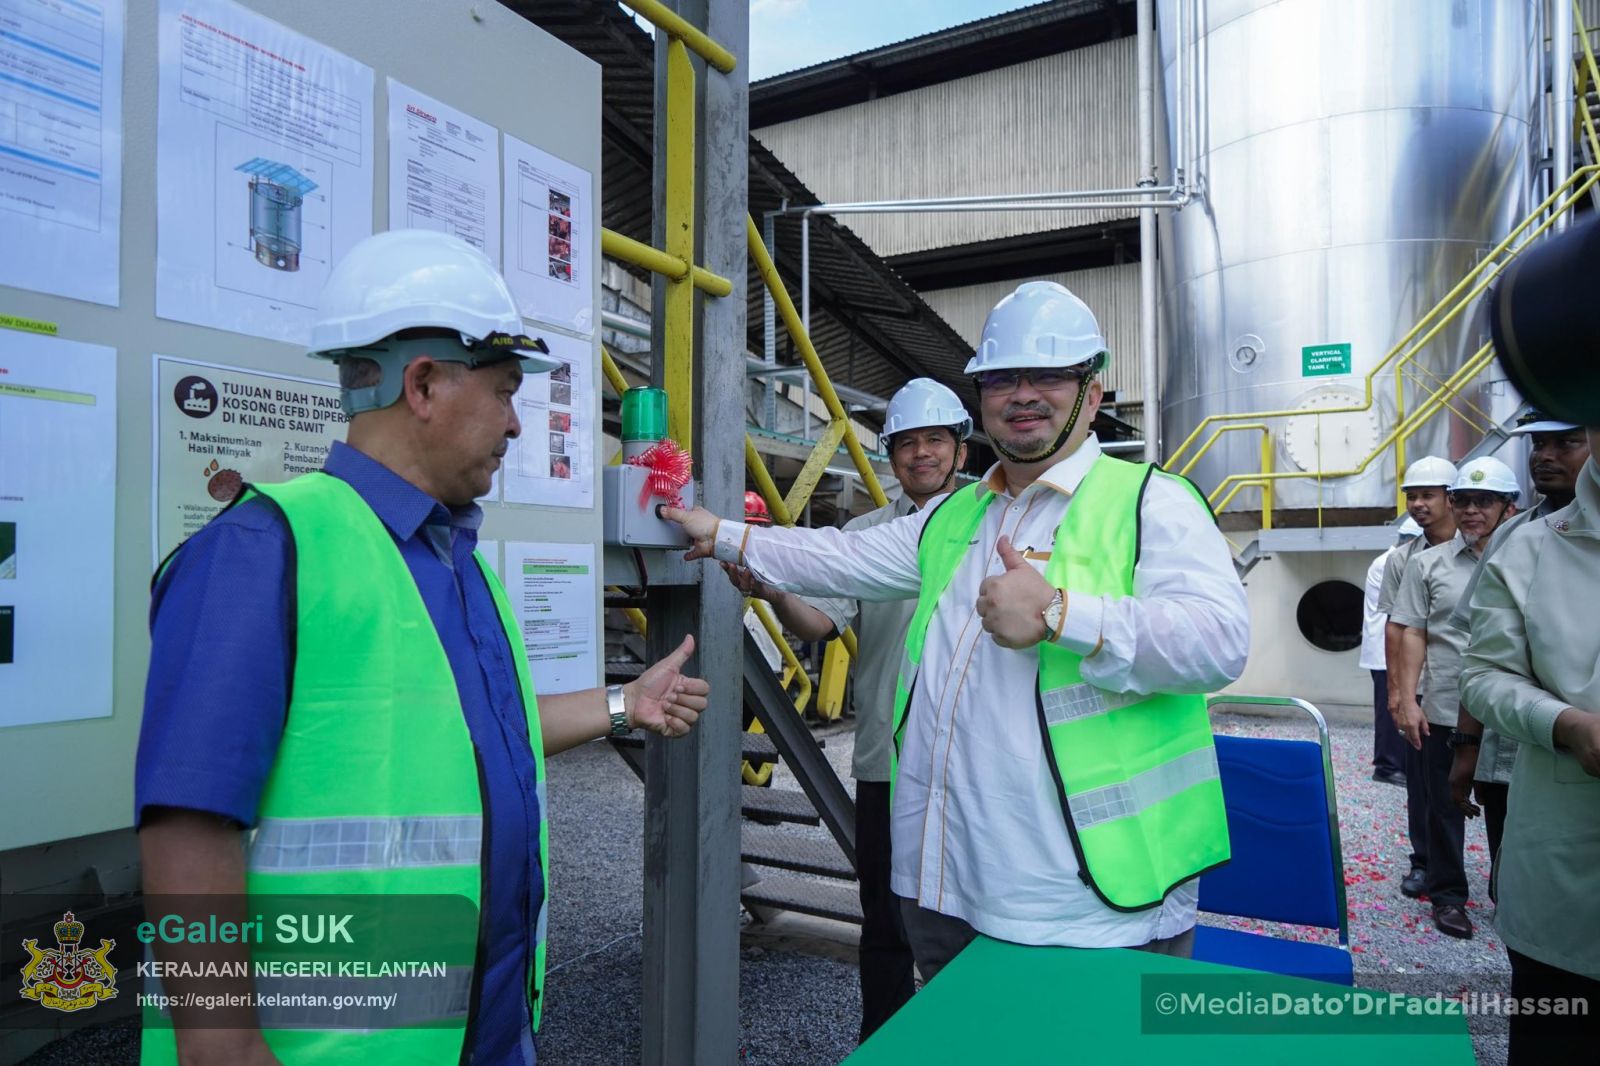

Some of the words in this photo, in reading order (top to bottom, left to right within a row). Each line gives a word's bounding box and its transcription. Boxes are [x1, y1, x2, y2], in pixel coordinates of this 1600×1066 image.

[0, 315, 13, 326] OW
[16, 319, 57, 333] DIAGRAM
[1310, 356, 1343, 364] CLARIFIER
[222, 382, 272, 400] TUJUAN
[275, 390, 308, 405] BUAH
[311, 396, 341, 410] TAND
[222, 397, 276, 414] KOSONG
[279, 404, 310, 419] (EFB)
[312, 409, 350, 424] DIPERA
[222, 411, 235, 423] DI
[239, 414, 286, 430] KILANG
[288, 420, 325, 434] SAWIT
[179, 430, 187, 440] 1.
[190, 431, 262, 447] Maksimumkan
[188, 443, 214, 454] Hasil
[217, 446, 252, 459] Minyak
[284, 441, 292, 451] 2.
[294, 442, 329, 456] Kurangk
[283, 452, 324, 464] Pembazir
[283, 463, 319, 473] Pencem
